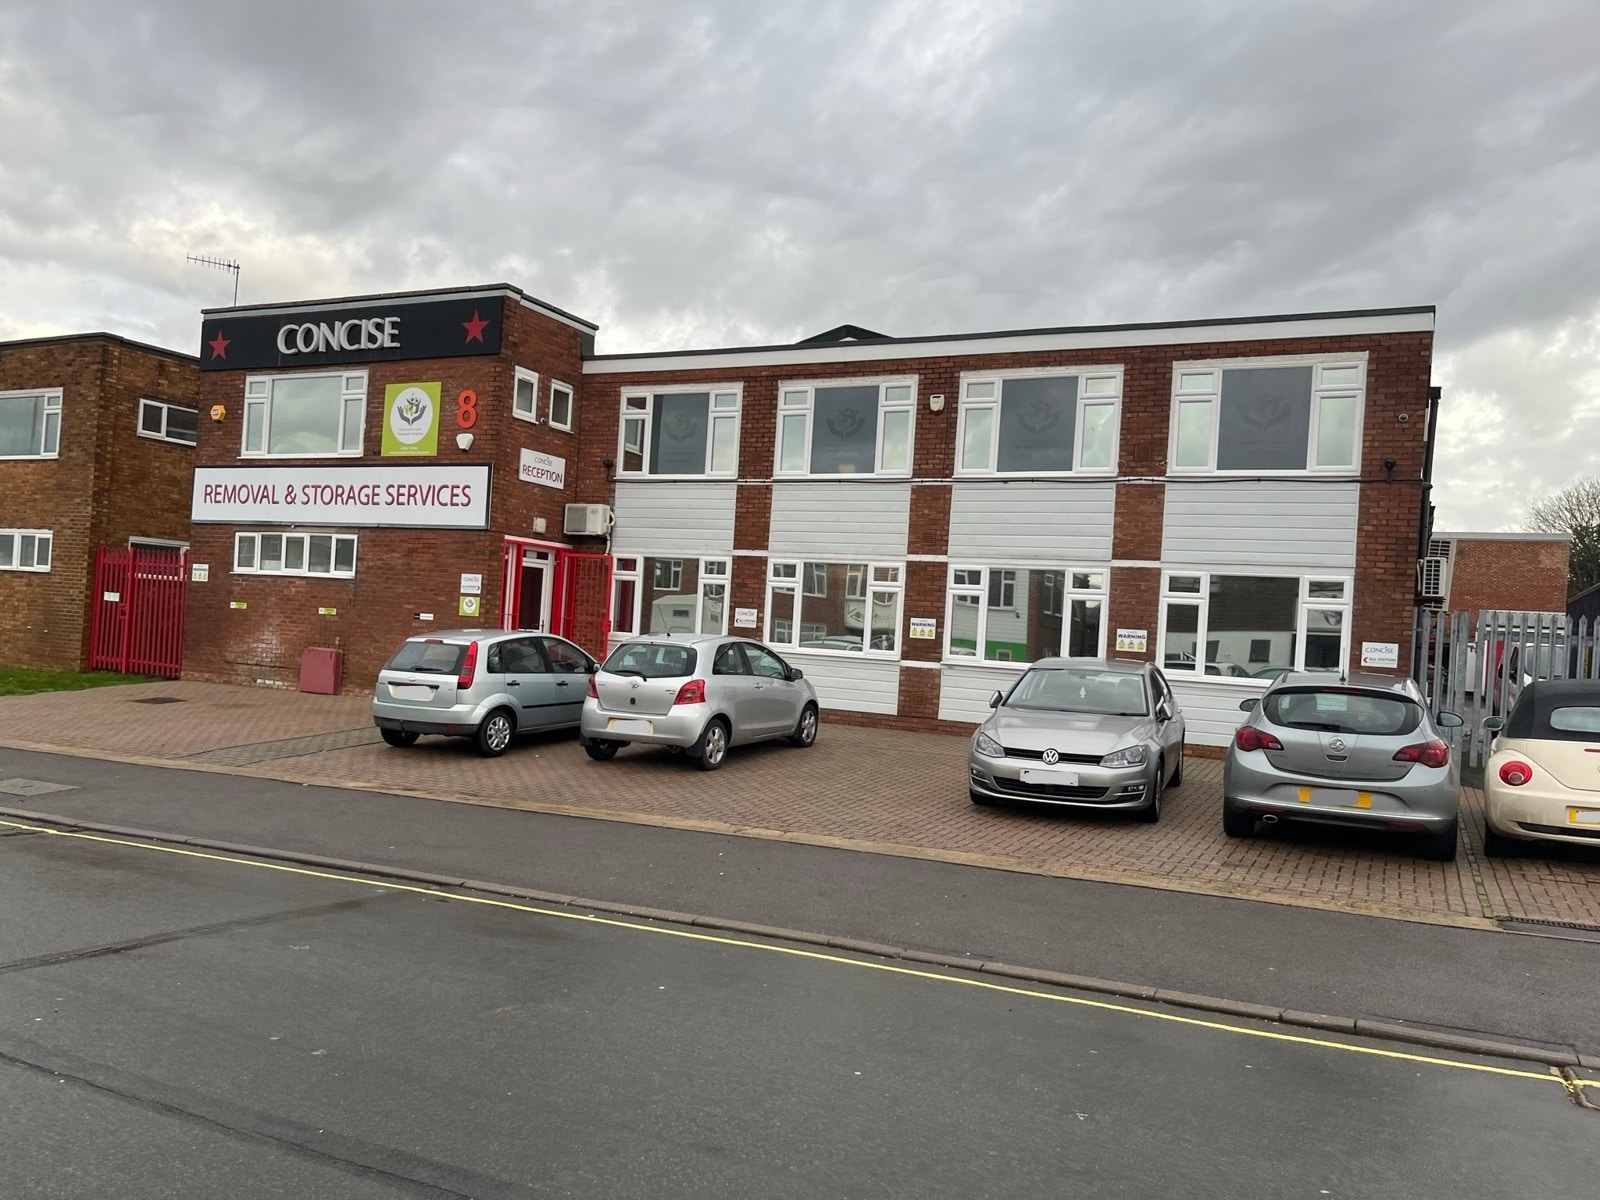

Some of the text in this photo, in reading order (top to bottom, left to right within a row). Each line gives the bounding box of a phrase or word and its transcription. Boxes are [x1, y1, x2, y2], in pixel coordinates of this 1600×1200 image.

[277, 316, 401, 354] CONCISE
[457, 389, 478, 429] 8
[522, 464, 563, 483] RECEPTION
[203, 484, 472, 507] REMOVAL & STORAGE SERVICES
[1365, 646, 1394, 654] CONCISE
